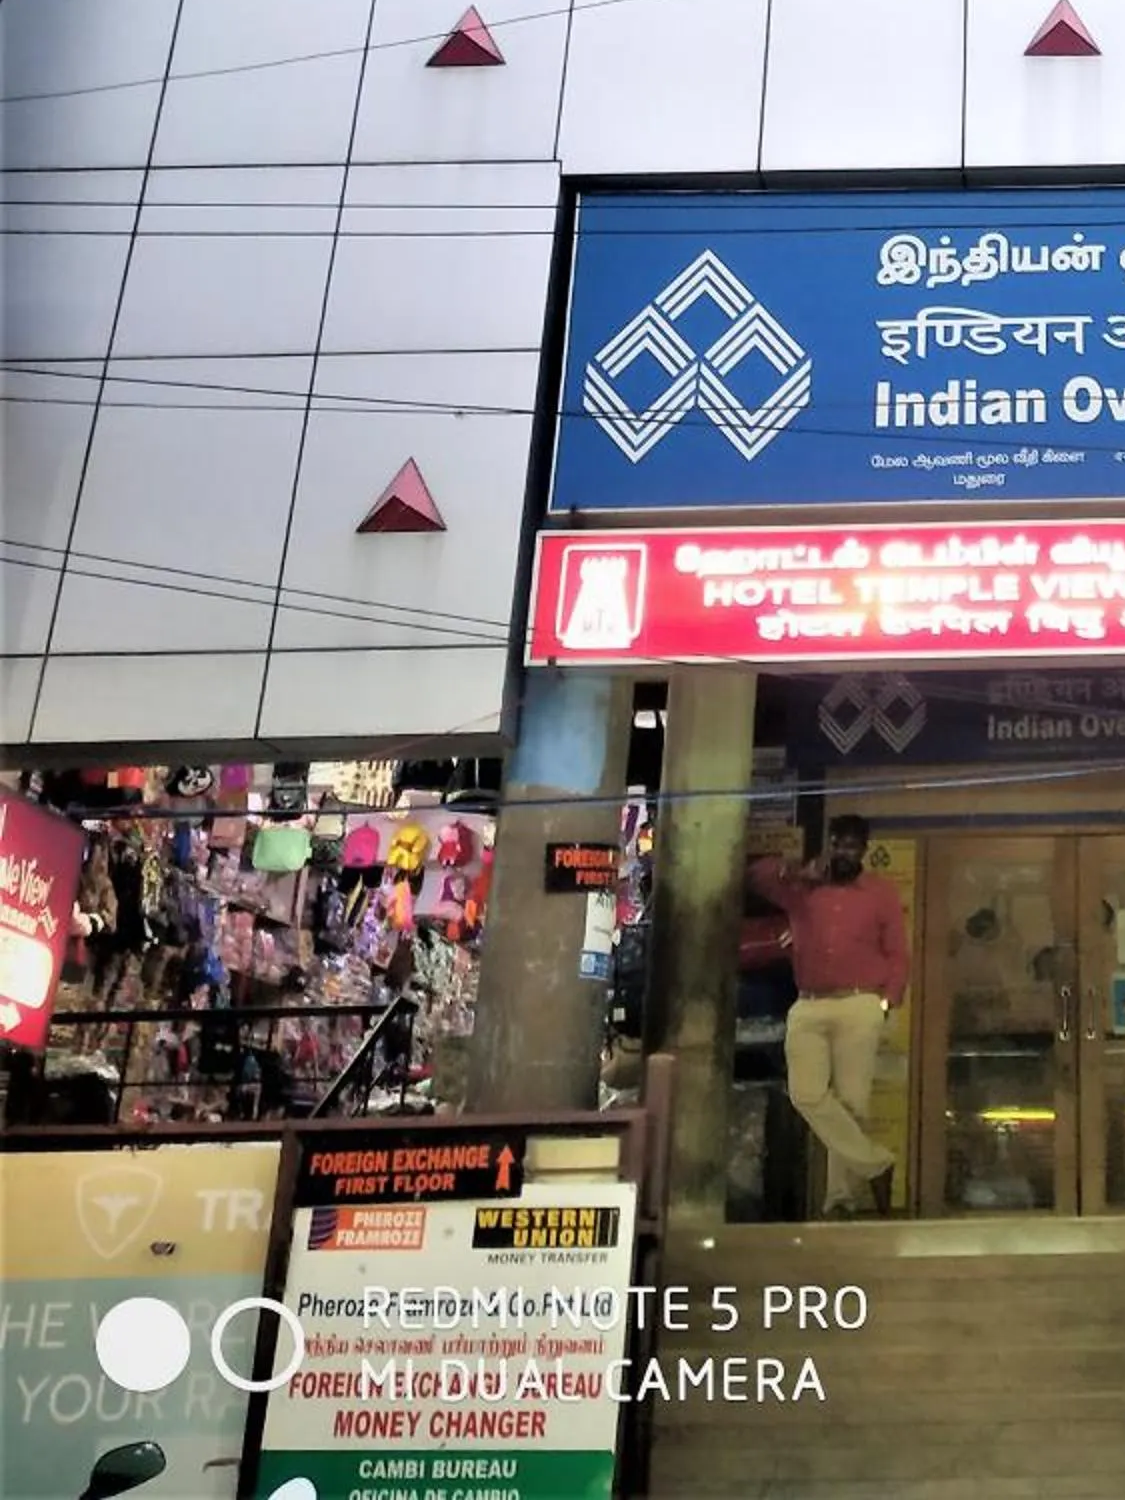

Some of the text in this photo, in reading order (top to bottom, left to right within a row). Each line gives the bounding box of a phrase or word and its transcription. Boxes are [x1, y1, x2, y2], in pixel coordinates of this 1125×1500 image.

[876, 232, 1105, 288] இந்தியன்
[876, 306, 1093, 365] इण्डियन
[875, 378, 1047, 427] Indian
[704, 577, 845, 607] HOTEL
[854, 574, 1020, 603] TEMPLE
[986, 714, 1073, 741] Indian
[310, 1145, 491, 1176] FOREIGN EXCHANGE
[334, 1173, 456, 1197] FIRST FLOOR
[196, 1188, 272, 1234] TR
[476, 1208, 596, 1229] WESTERN
[512, 1229, 595, 1248] UNION
[486, 1252, 609, 1265] MONEY TRANSFER
[288, 1372, 385, 1399] FOREIGN
[519, 1372, 603, 1399] BUREAU
[333, 1410, 547, 1439] MONEY CHANGER
[358, 1459, 518, 1479] CAMBI BUREAU
